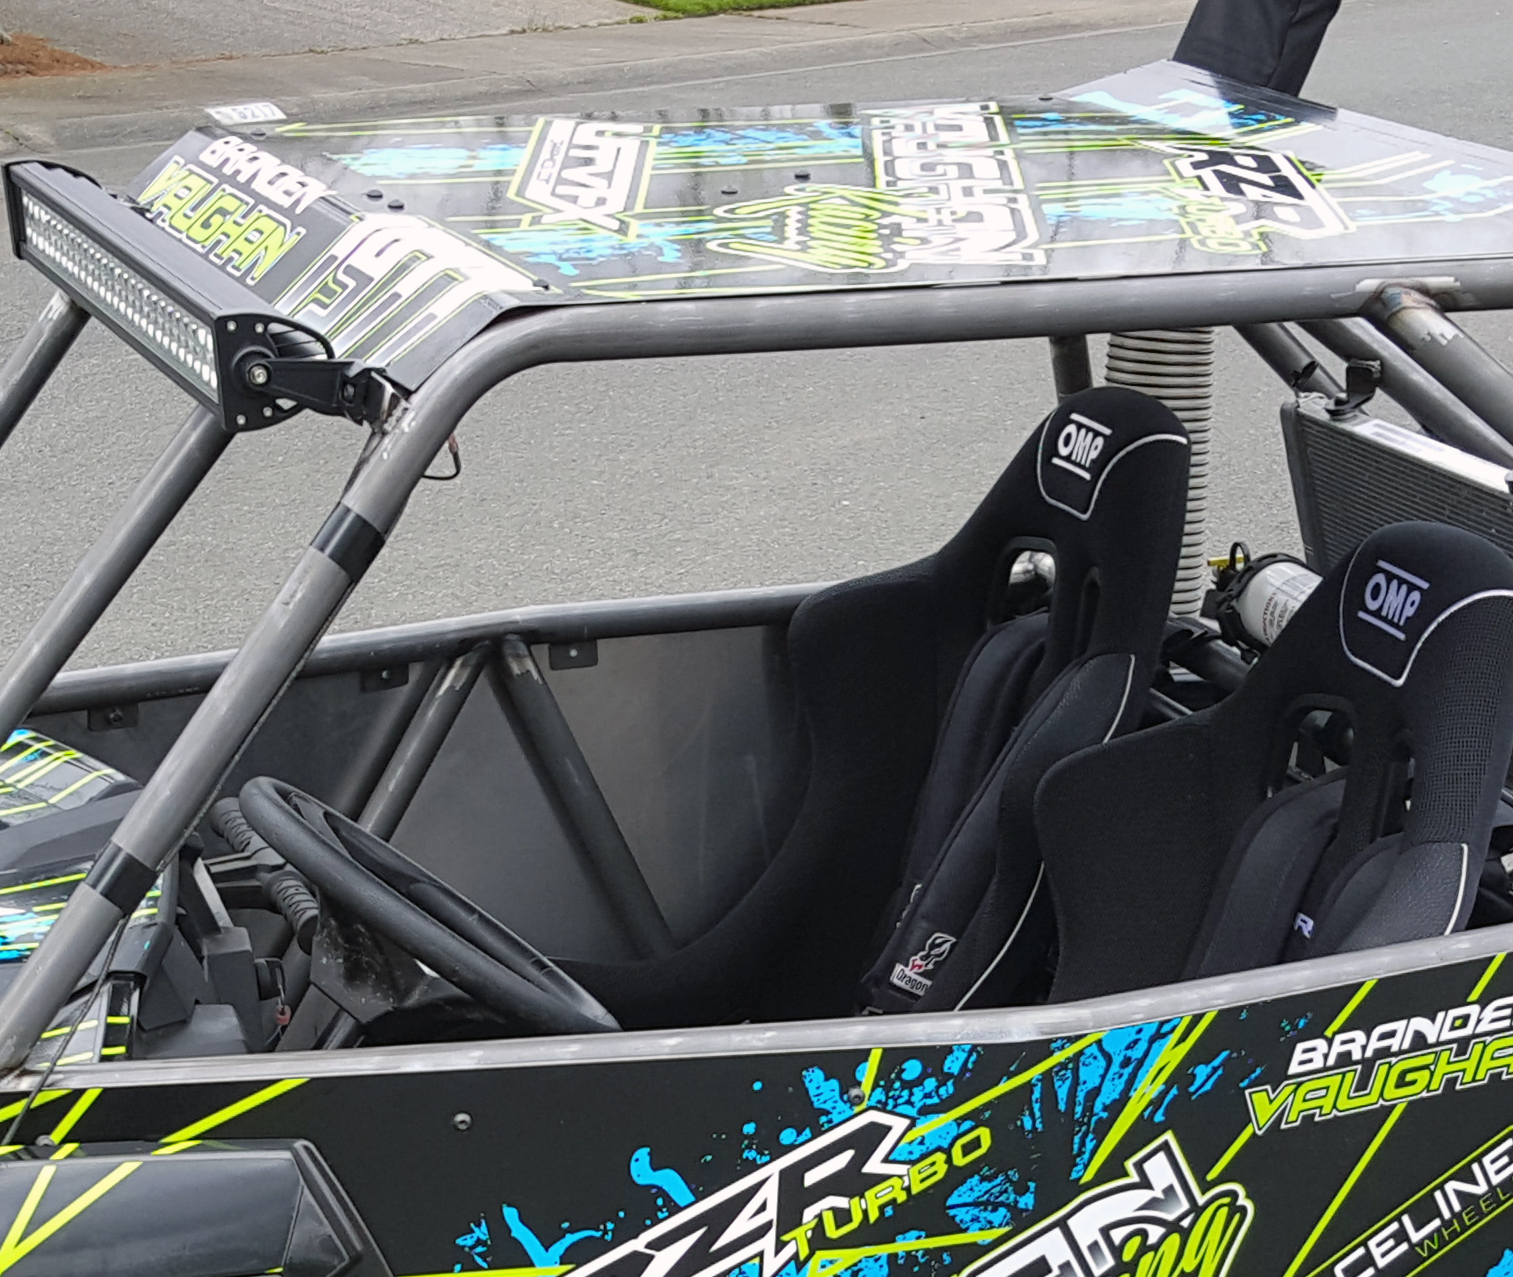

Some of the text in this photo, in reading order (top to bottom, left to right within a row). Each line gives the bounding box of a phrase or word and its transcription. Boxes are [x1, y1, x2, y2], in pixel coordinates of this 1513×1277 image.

[137, 155, 307, 286] VAUGHAN
[1058, 423, 1105, 468] OMP
[1364, 572, 1421, 627] OMP
[780, 1126, 992, 1263] TURBO
